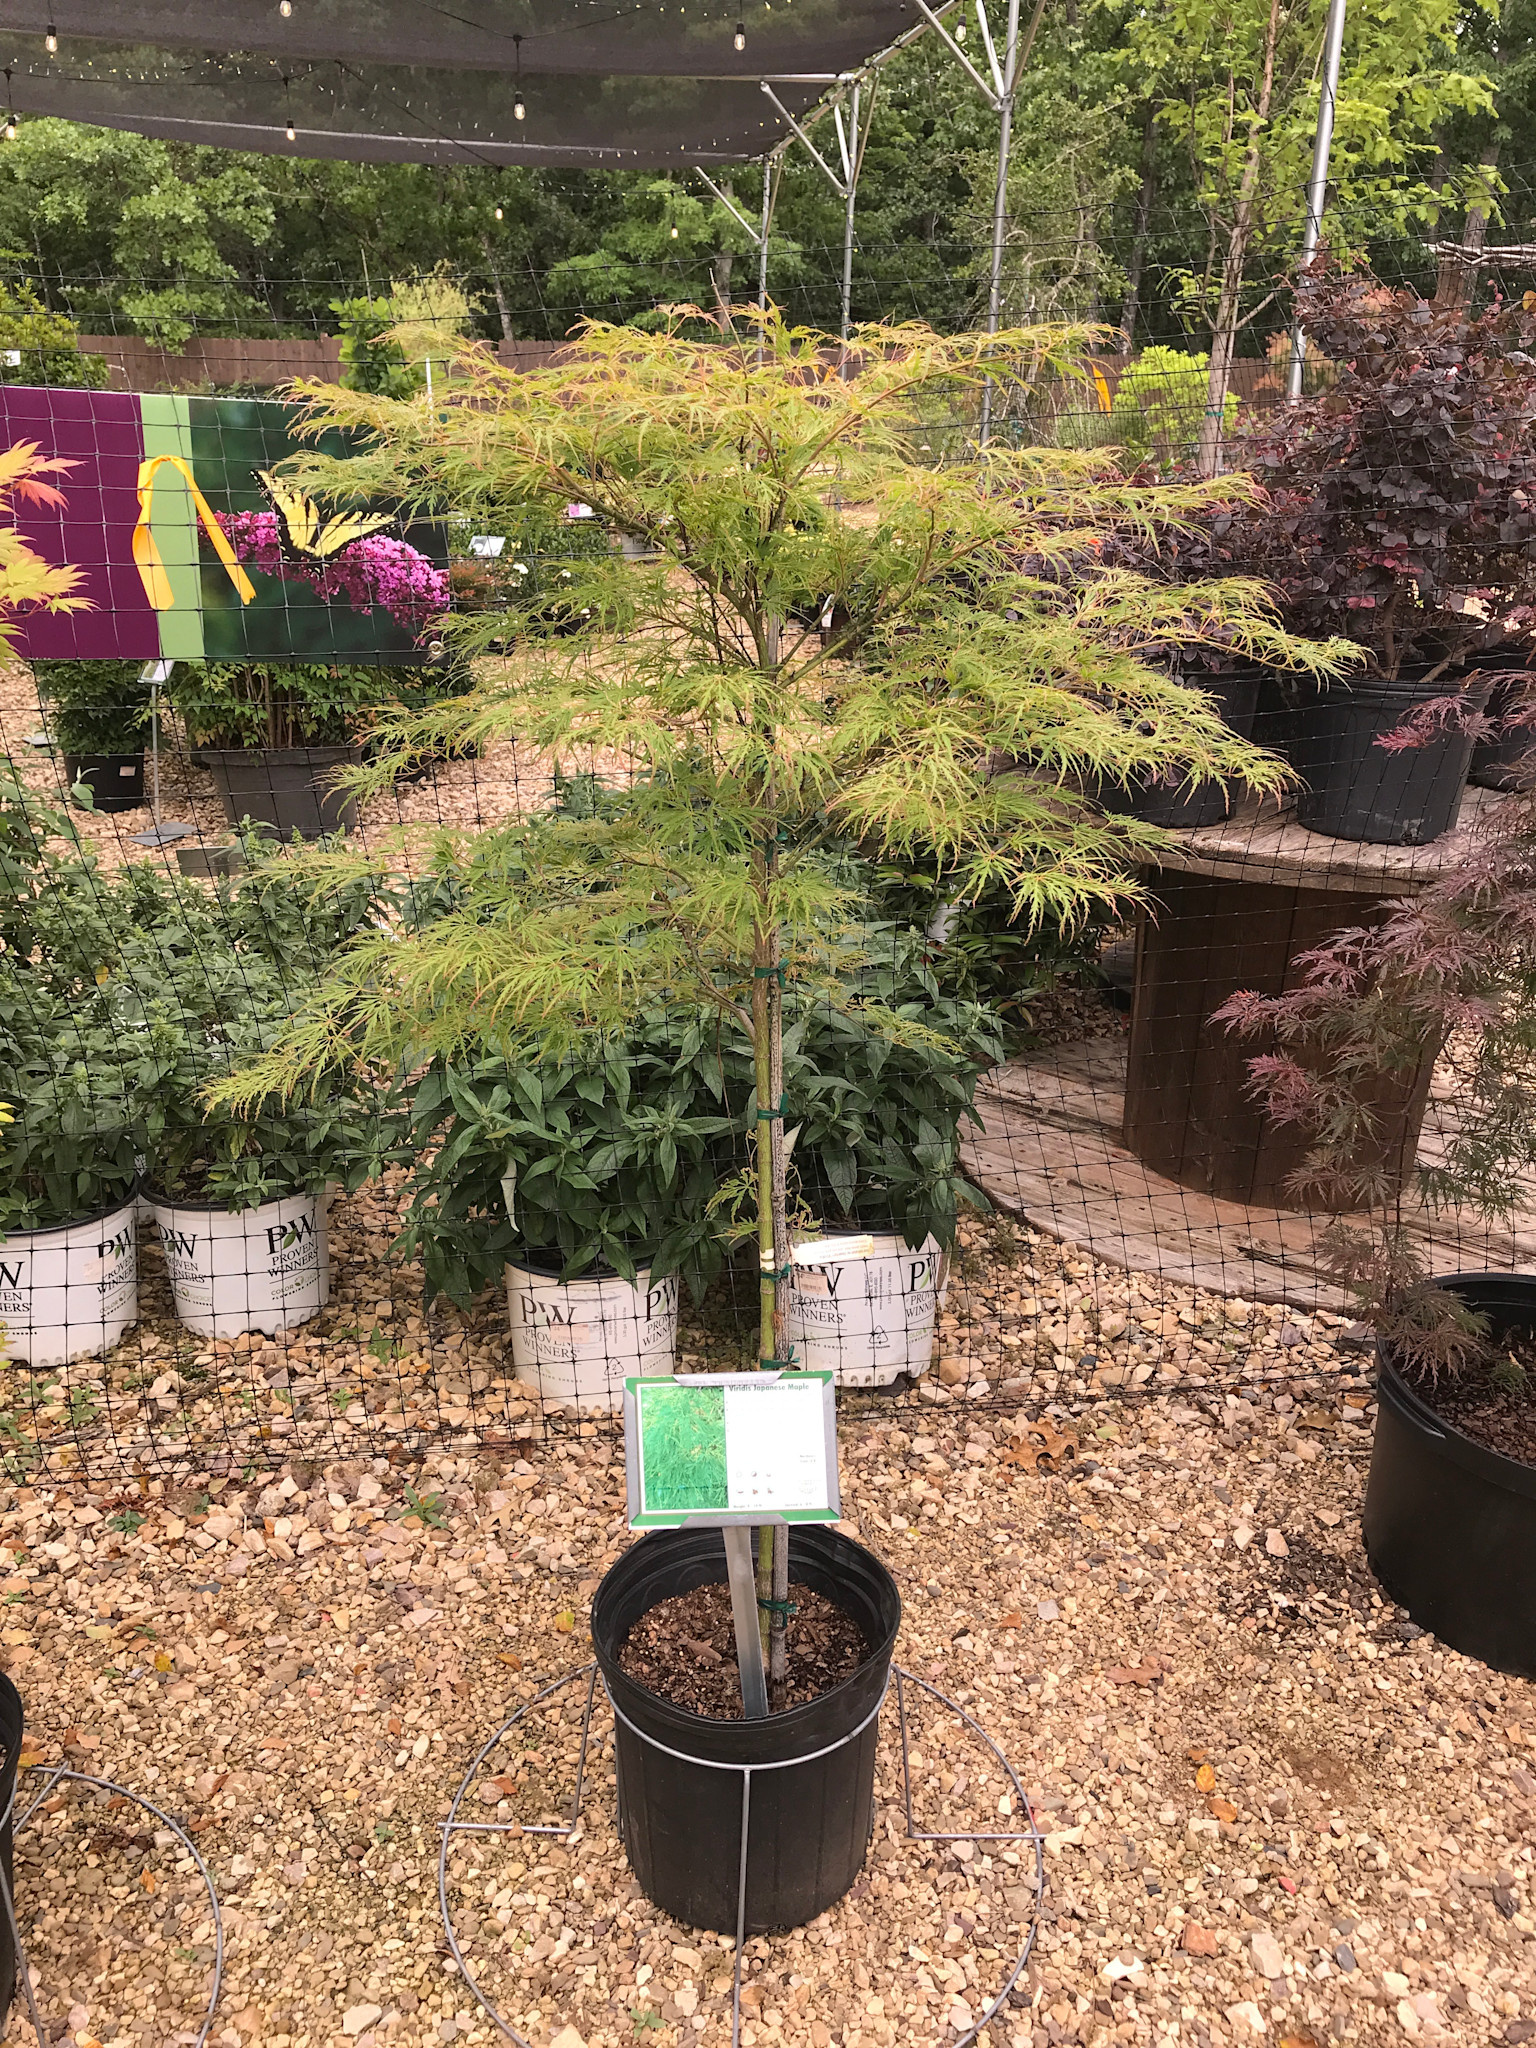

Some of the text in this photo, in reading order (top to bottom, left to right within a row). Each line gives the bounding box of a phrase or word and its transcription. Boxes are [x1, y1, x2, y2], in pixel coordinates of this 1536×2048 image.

[264, 1208, 315, 1256] PW
[105, 1253, 133, 1279] ROVEN
[267, 1248, 319, 1277] WINNERS
[272, 1240, 316, 1266] PROVEN
[271, 1284, 294, 1296] COLOR
[643, 1278, 676, 1324] PW
[792, 1293, 838, 1311] PROVEN
[519, 1293, 577, 1331] PW
[790, 1305, 844, 1324] WINNERS
[523, 1335, 578, 1360] WINNERS
[729, 1382, 810, 1392] Viridis Japanese Maple
